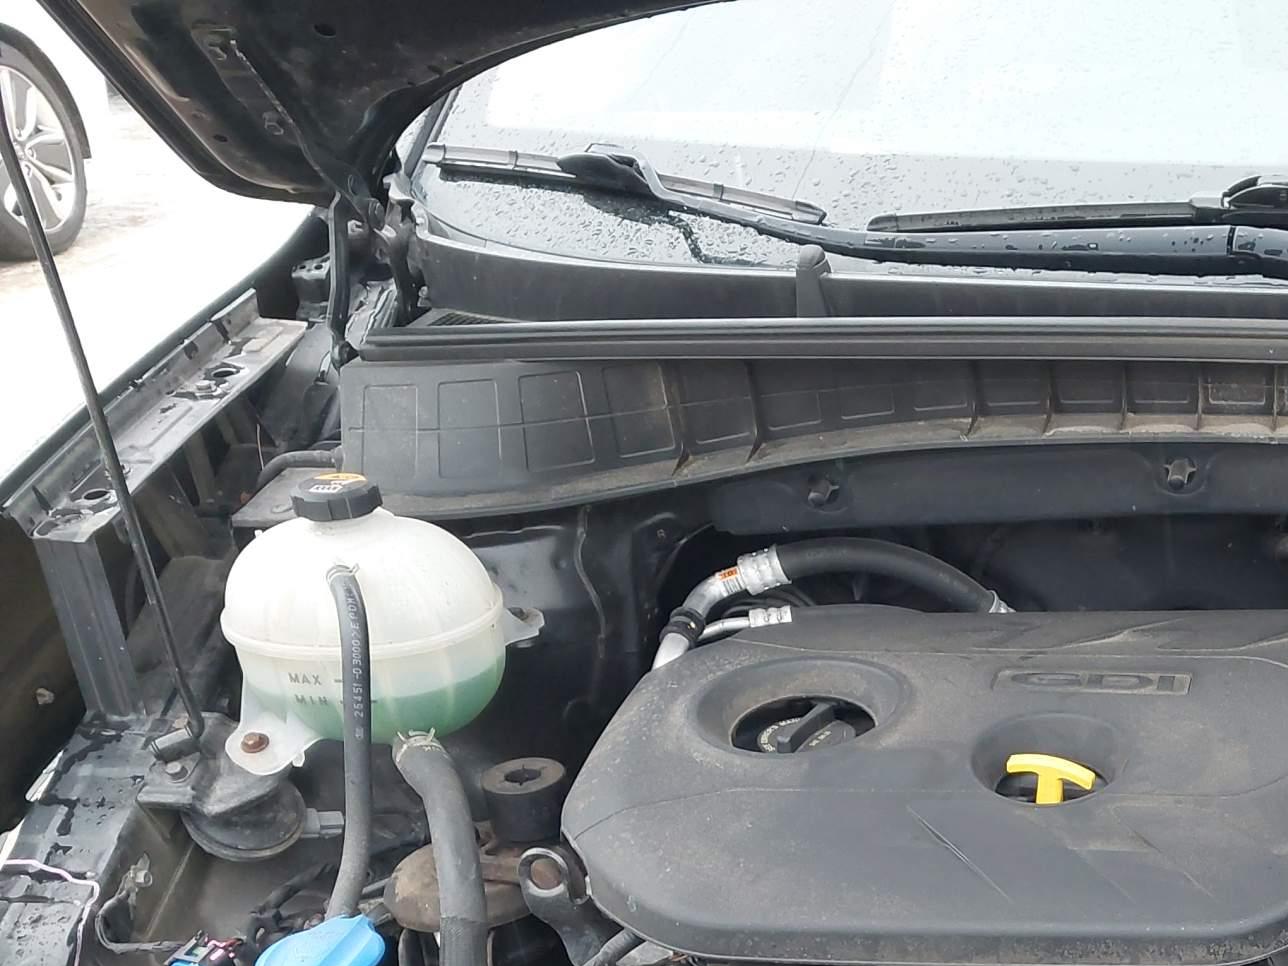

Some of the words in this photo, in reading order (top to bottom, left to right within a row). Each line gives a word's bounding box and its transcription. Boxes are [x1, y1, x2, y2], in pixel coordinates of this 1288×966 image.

[288, 672, 322, 686] MAX
[1010, 672, 1176, 694] GDI
[294, 694, 328, 705] MIN
